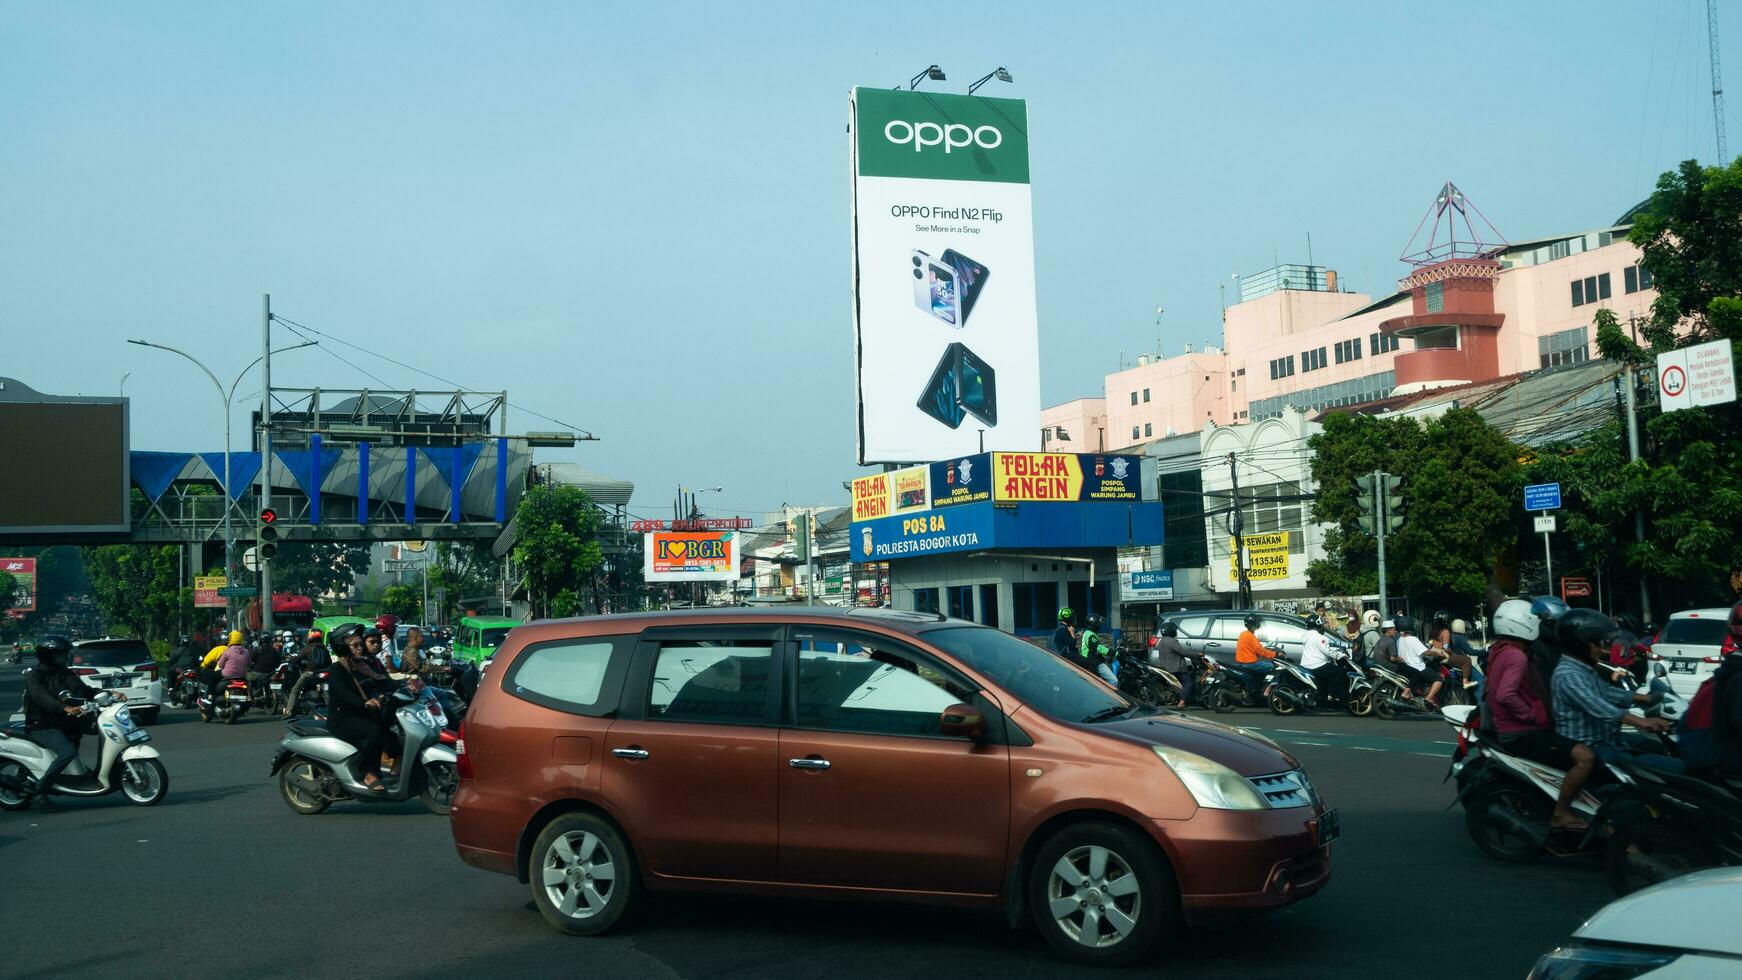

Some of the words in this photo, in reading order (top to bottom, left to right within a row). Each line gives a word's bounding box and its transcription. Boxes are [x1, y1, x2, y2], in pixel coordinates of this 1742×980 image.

[885, 120, 1002, 153] oppo
[891, 205, 930, 218] OPPO
[933, 207, 959, 219] Find
[962, 208, 979, 220] N2
[981, 209, 1003, 223] Flip
[915, 224, 930, 232] See
[930, 225, 949, 233] More
[962, 226, 981, 234] Snap
[1001, 454, 1069, 477] TOLAK
[854, 476, 887, 499] TOLAK
[952, 487, 969, 496] POSPOL
[1004, 477, 1069, 499] ANGIN
[857, 496, 887, 518] ANGIN
[934, 497, 953, 506] SIMPANG
[953, 494, 973, 503] WARUNG
[973, 492, 989, 500] JAMBU
[903, 517, 927, 536] POS
[930, 515, 945, 532] 8A
[658, 540, 669, 559] I
[686, 539, 726, 559] BGR
[876, 539, 919, 555] POLRESTA
[919, 535, 951, 551] BOGOR
[952, 532, 978, 547] KOTA
[1246, 536, 1281, 547] SEWAKAN
[1141, 574, 1155, 583] NSC
